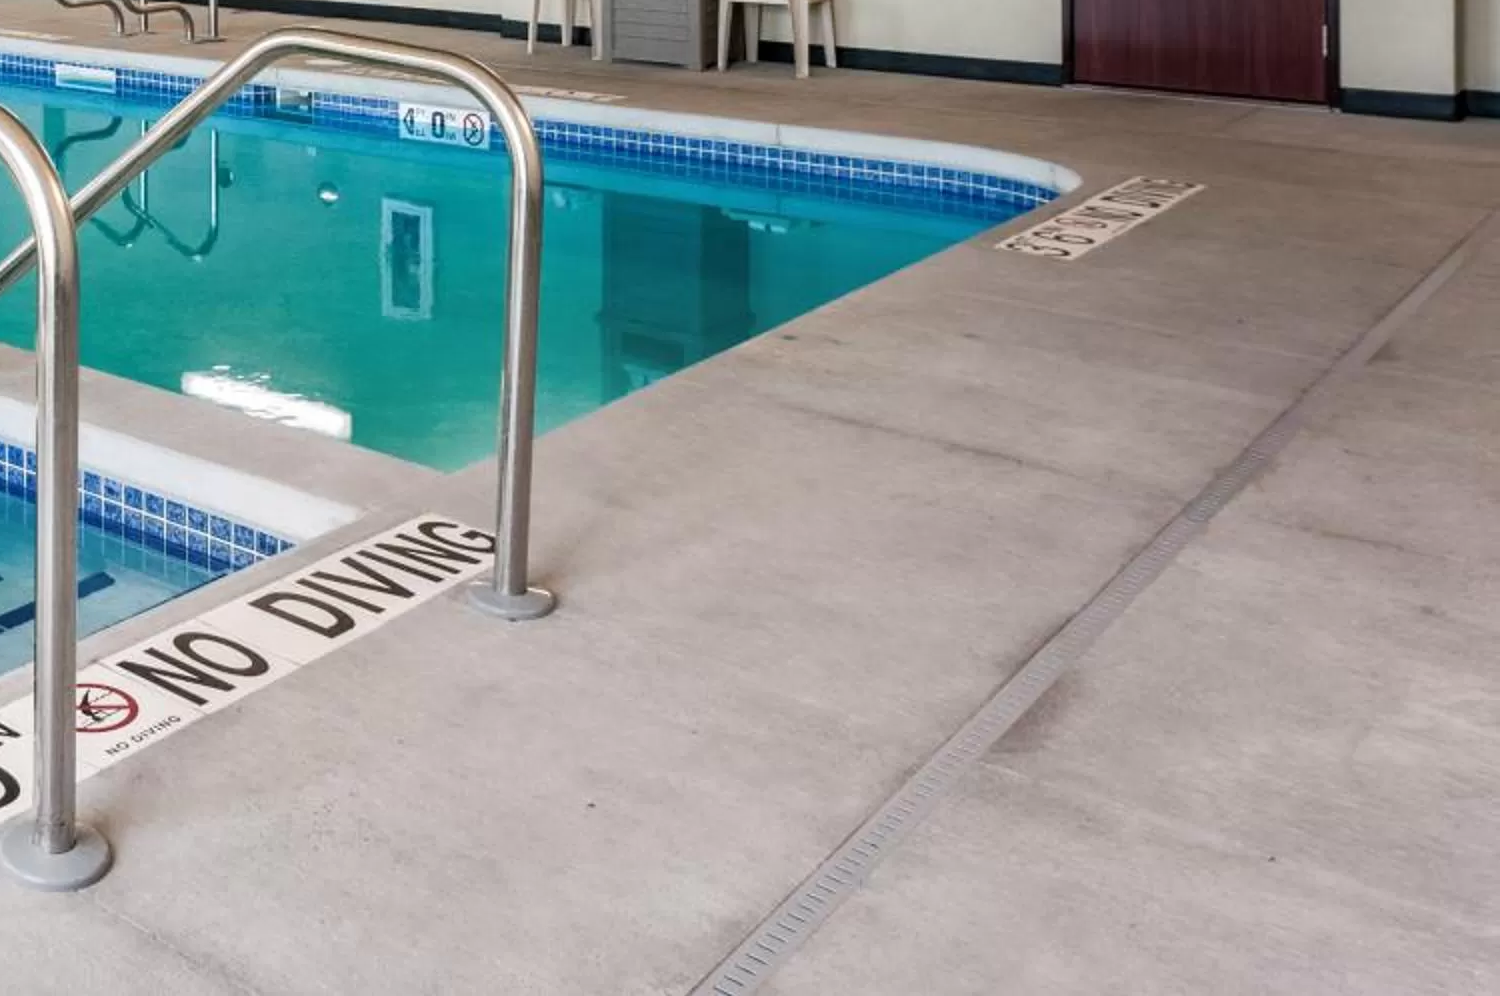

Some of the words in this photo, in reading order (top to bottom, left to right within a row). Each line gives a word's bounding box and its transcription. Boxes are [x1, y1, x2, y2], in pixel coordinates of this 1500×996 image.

[116, 631, 270, 706] NO
[248, 521, 497, 638] DIVING
[105, 741, 130, 756] NO
[130, 715, 182, 742] DIVING
